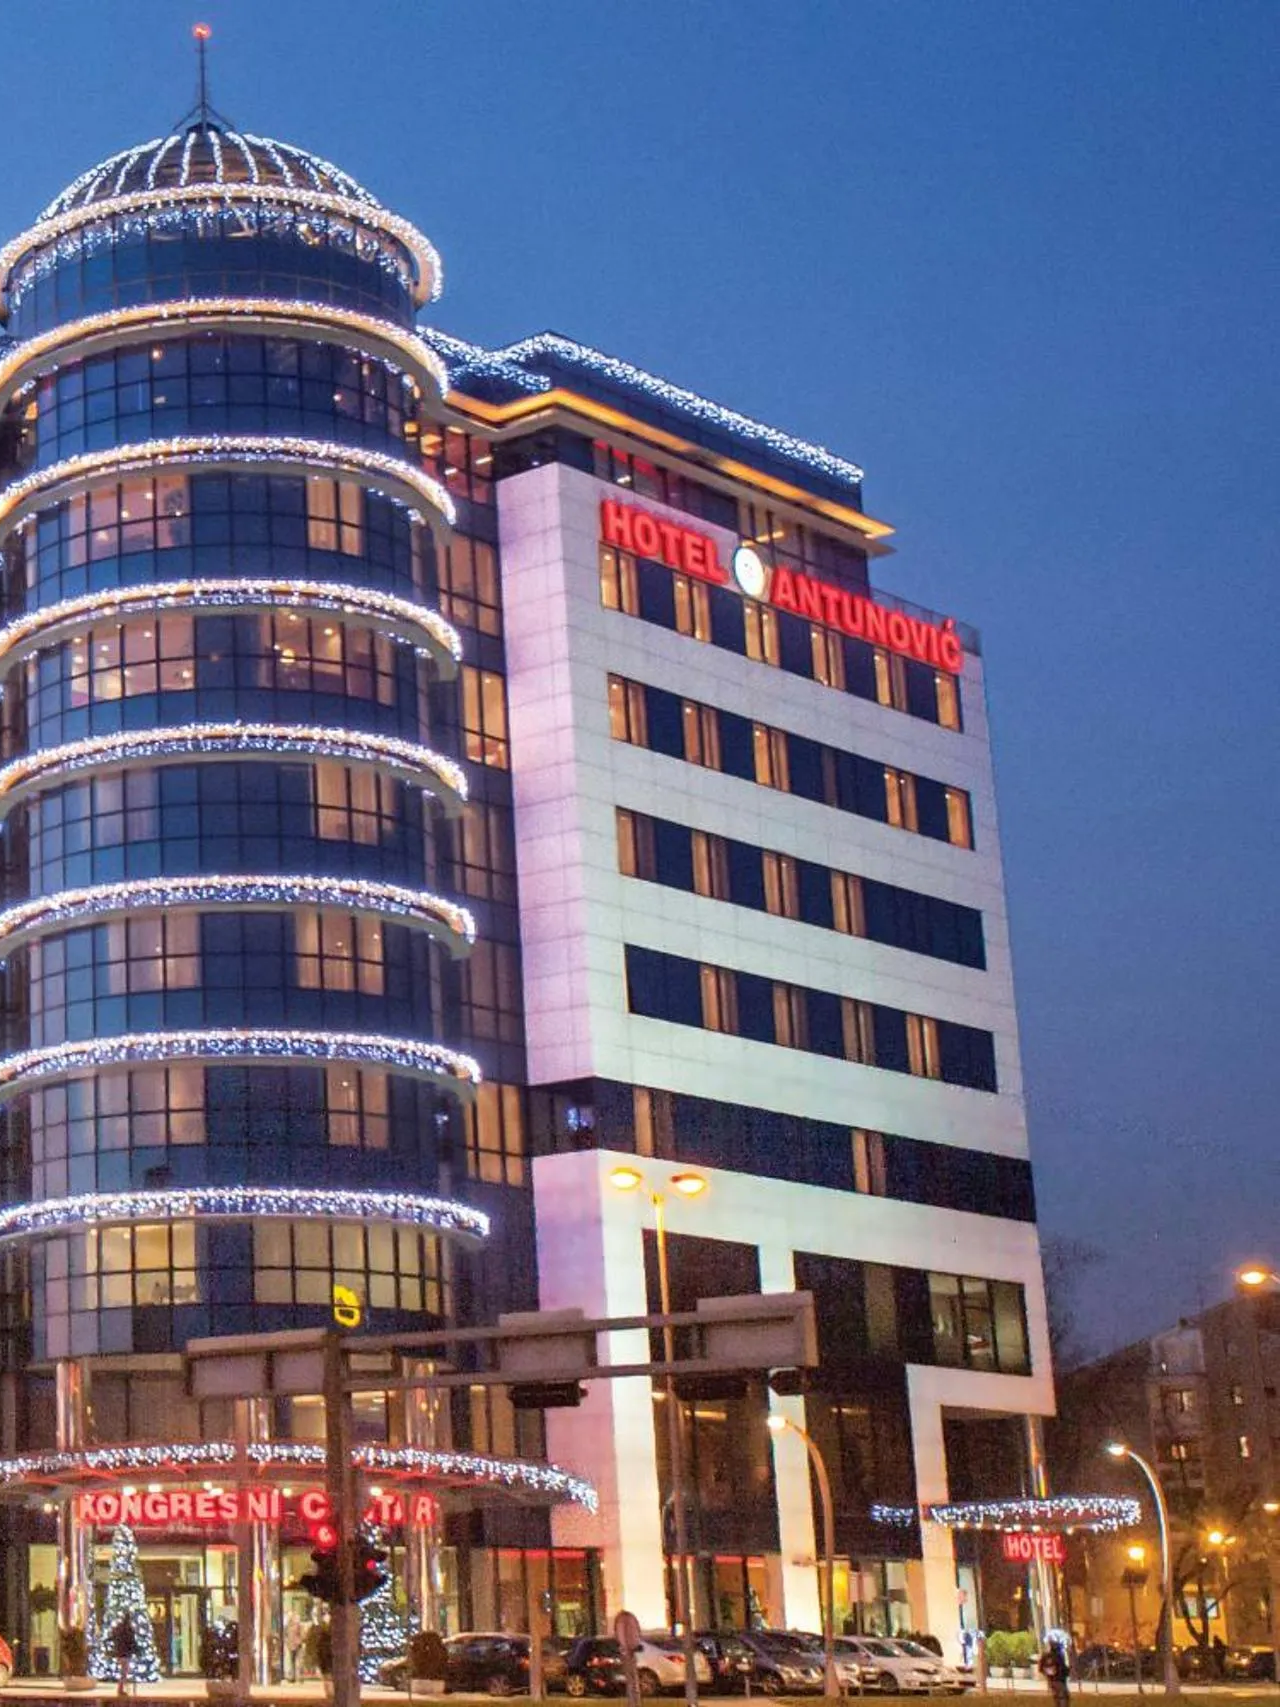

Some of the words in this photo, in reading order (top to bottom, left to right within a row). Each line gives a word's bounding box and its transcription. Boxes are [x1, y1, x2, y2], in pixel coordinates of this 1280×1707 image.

[600, 497, 729, 585] HOTEL
[769, 565, 964, 674] ANTUNOVIĆ
[1004, 1535, 1063, 1560] HOTEL
